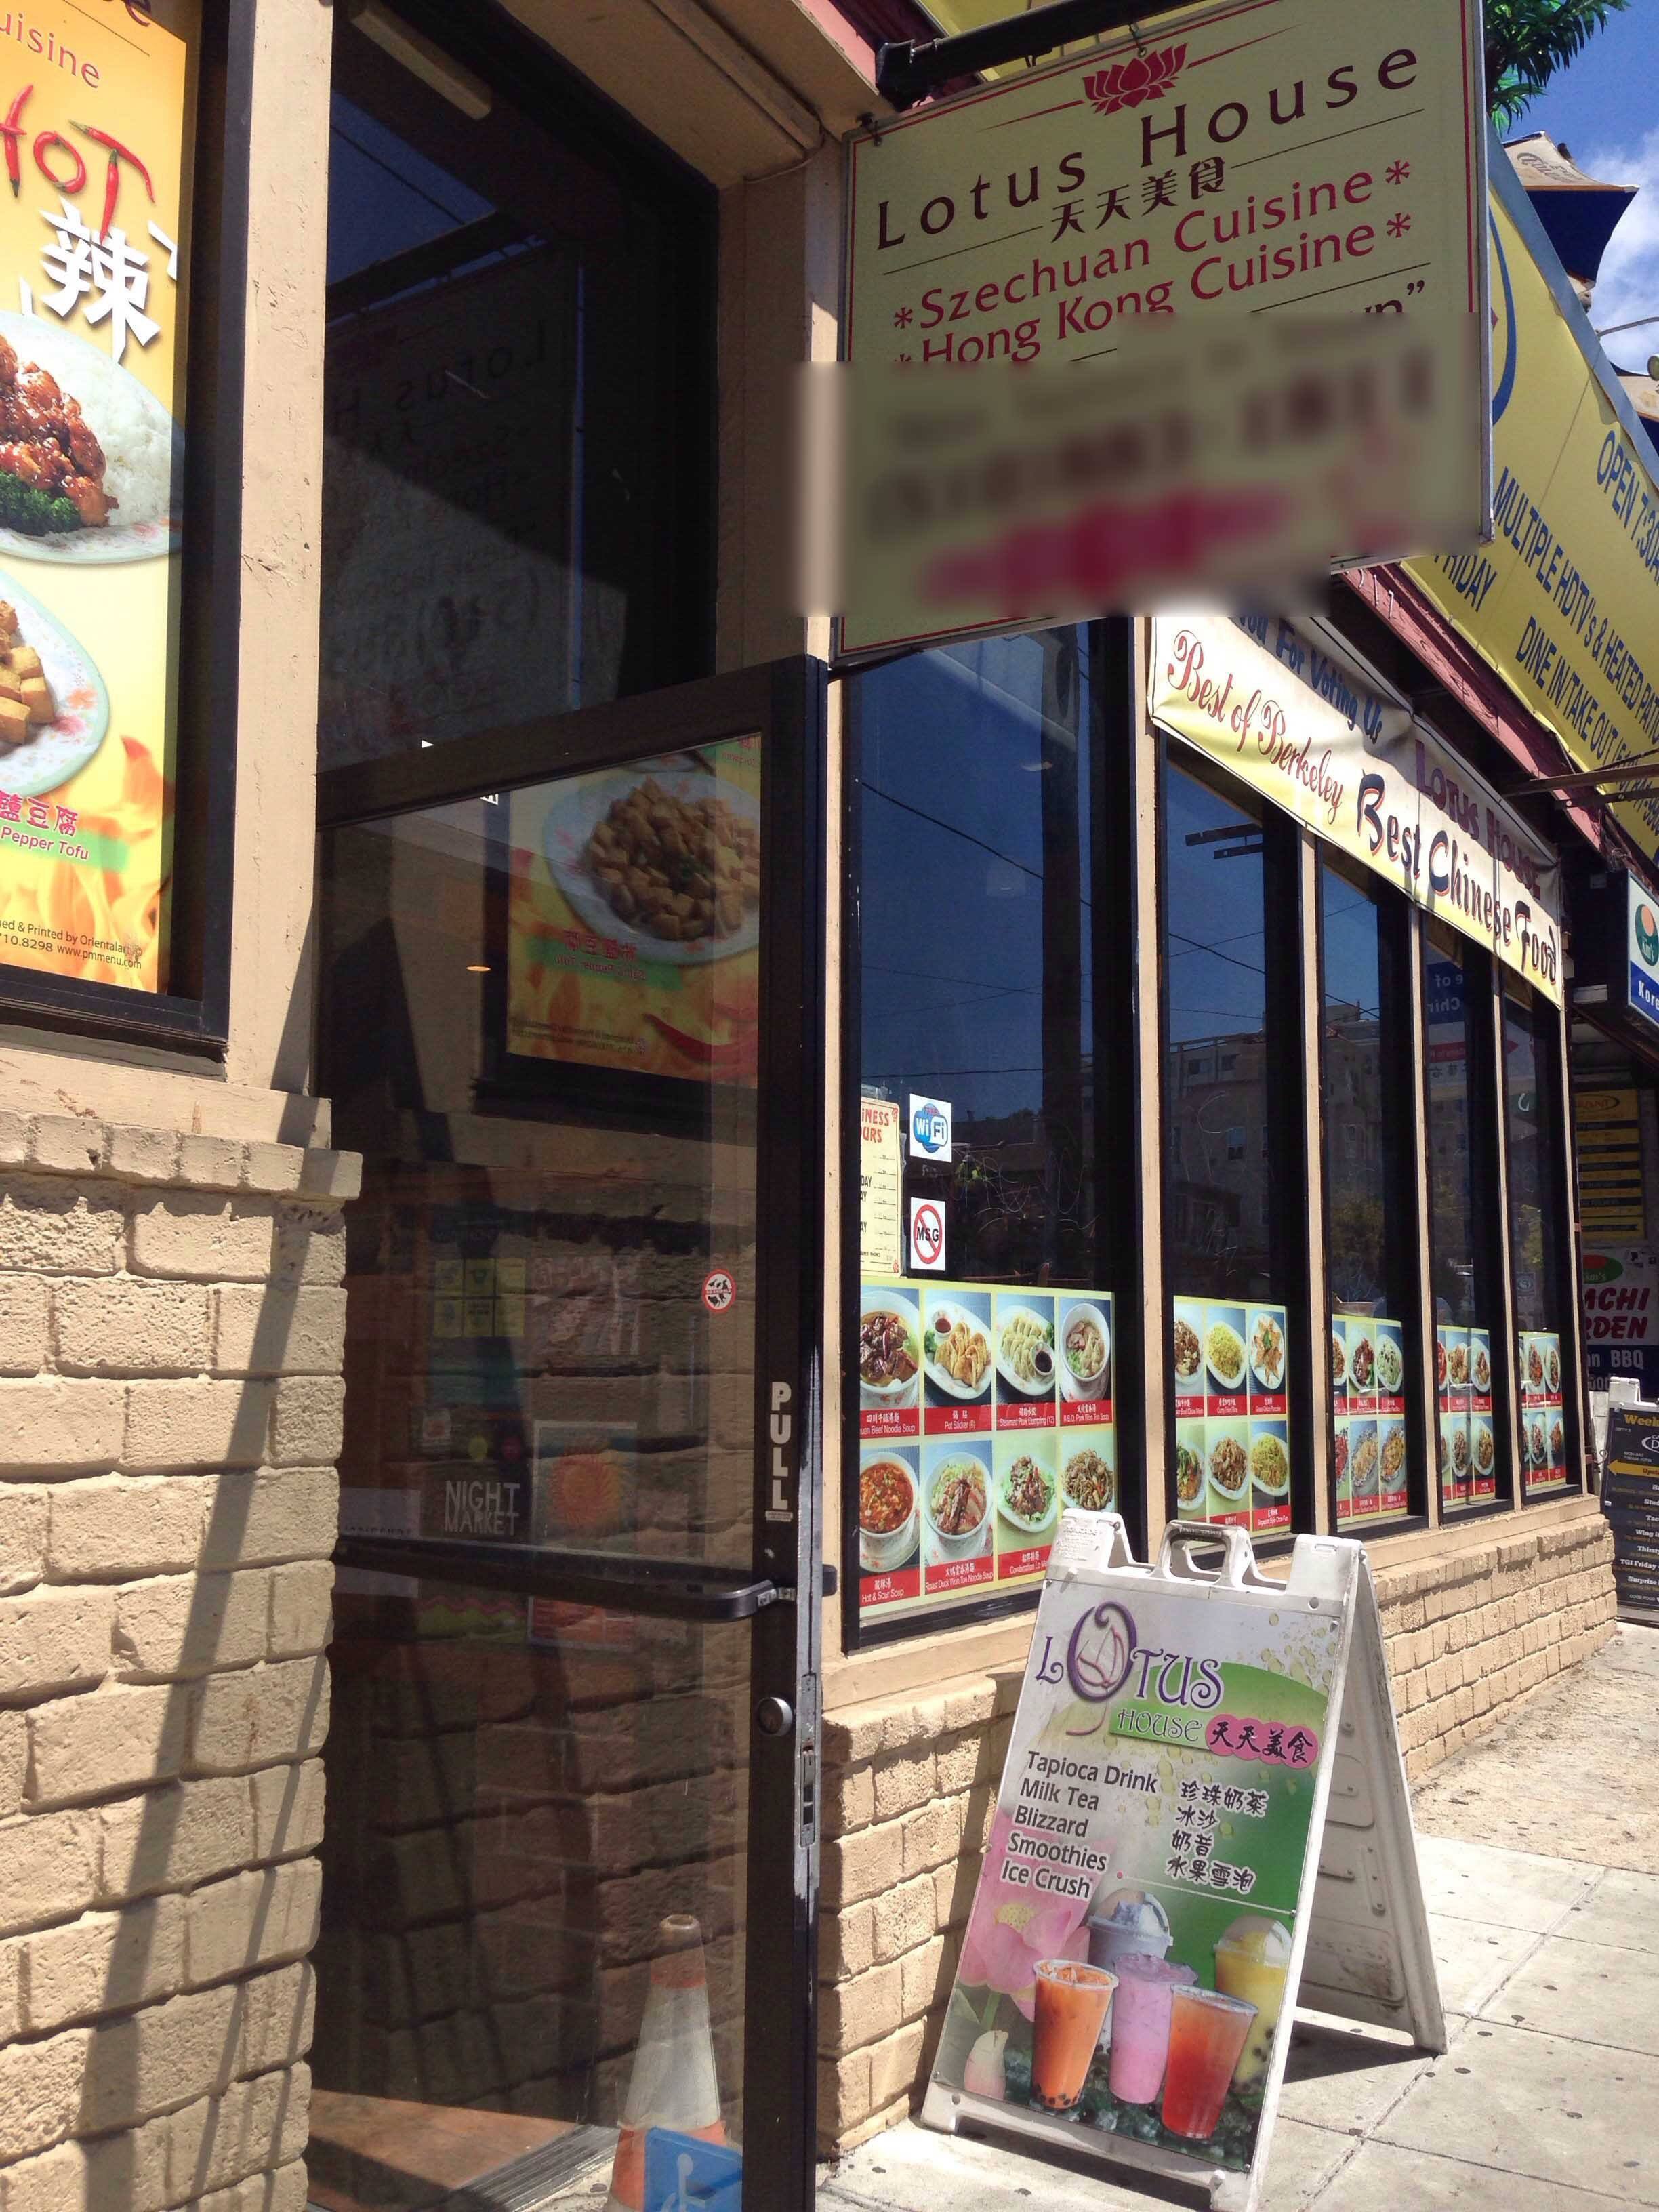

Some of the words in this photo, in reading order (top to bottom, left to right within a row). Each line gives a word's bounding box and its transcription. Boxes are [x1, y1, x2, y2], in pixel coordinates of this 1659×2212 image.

[877, 152, 1086, 251] Lotus
[1139, 48, 1418, 167] House
[1050, 157, 1226, 244] 天天美食
[1057, 281, 1175, 340] Kong
[1596, 430, 1640, 529] OPEN
[1630, 492, 1659, 586] 7:30A
[1493, 466, 1565, 594] MULTIPLE
[1553, 558, 1597, 649] HDTV's
[1591, 617, 1608, 662] &
[1276, 617, 1305, 675] For
[1311, 649, 1358, 731] Voting
[1599, 628, 1645, 711] HEATED
[1515, 615, 1557, 689] DINE
[1546, 655, 1599, 742] IN/TAKE
[1589, 712, 1619, 766] OUT
[1167, 629, 1234, 723] Best
[1231, 689, 1263, 752] of
[1258, 699, 1345, 825] Berkeley
[1, 826, 54, 851] Pepper
[58, 840, 89, 861] Tofu
[1356, 769, 1422, 880] Best
[1429, 830, 1512, 947] Chinese
[1515, 900, 1557, 986] Food
[17, 921, 25, 933] &
[27, 923, 64, 940] Printed
[66, 930, 78, 945] by
[56, 945, 142, 970] www.pmmenu.com
[916, 1227, 939, 1242] MSG
[1610, 1349, 1643, 1369] BBQ
[872, 1425, 884, 1435] Beef
[884, 1425, 902, 1433] Noodle
[902, 1424, 916, 1433] Soup
[944, 1420, 953, 1430] Pot
[953, 1420, 968, 1429] Sticker
[769, 1381, 792, 1510] PULL
[444, 1479, 521, 1513] NIGHT
[444, 1511, 521, 1537] MARKET
[926, 1582, 938, 1591] Roast
[938, 1580, 949, 1589] Duck
[949, 1578, 960, 1587] Won
[960, 1576, 968, 1584] Ton
[968, 1573, 983, 1583] Noodle
[983, 1571, 994, 1581] Soup
[1620, 1559, 1633, 1568] TGI
[1634, 1560, 1657, 1571] Friday
[1627, 1576, 1658, 1586] Surprise
[861, 1594, 872, 1603] Hot
[872, 1593, 877, 1601] &
[878, 1591, 890, 1601] Sour
[890, 1589, 904, 1599] Soup
[1211, 1721, 1314, 1764] 天天美食
[1027, 1750, 1099, 1783] Tapioca
[1103, 1765, 1158, 1794] Drink
[1020, 1778, 1060, 1803] Milk
[1068, 1786, 1099, 1812] Tea
[1180, 1780, 1268, 1817] 珍珠奶茶
[1014, 1805, 1089, 1839] Blizzard
[1176, 1805, 1220, 1829] 冰沙
[1008, 1834, 1107, 1872] Smoothies
[1171, 1830, 1213, 1858] 奶昔
[1002, 1860, 1030, 1885] Ice
[1034, 1871, 1091, 1898] Crush
[1167, 1856, 1256, 1894] 水果雪泡
